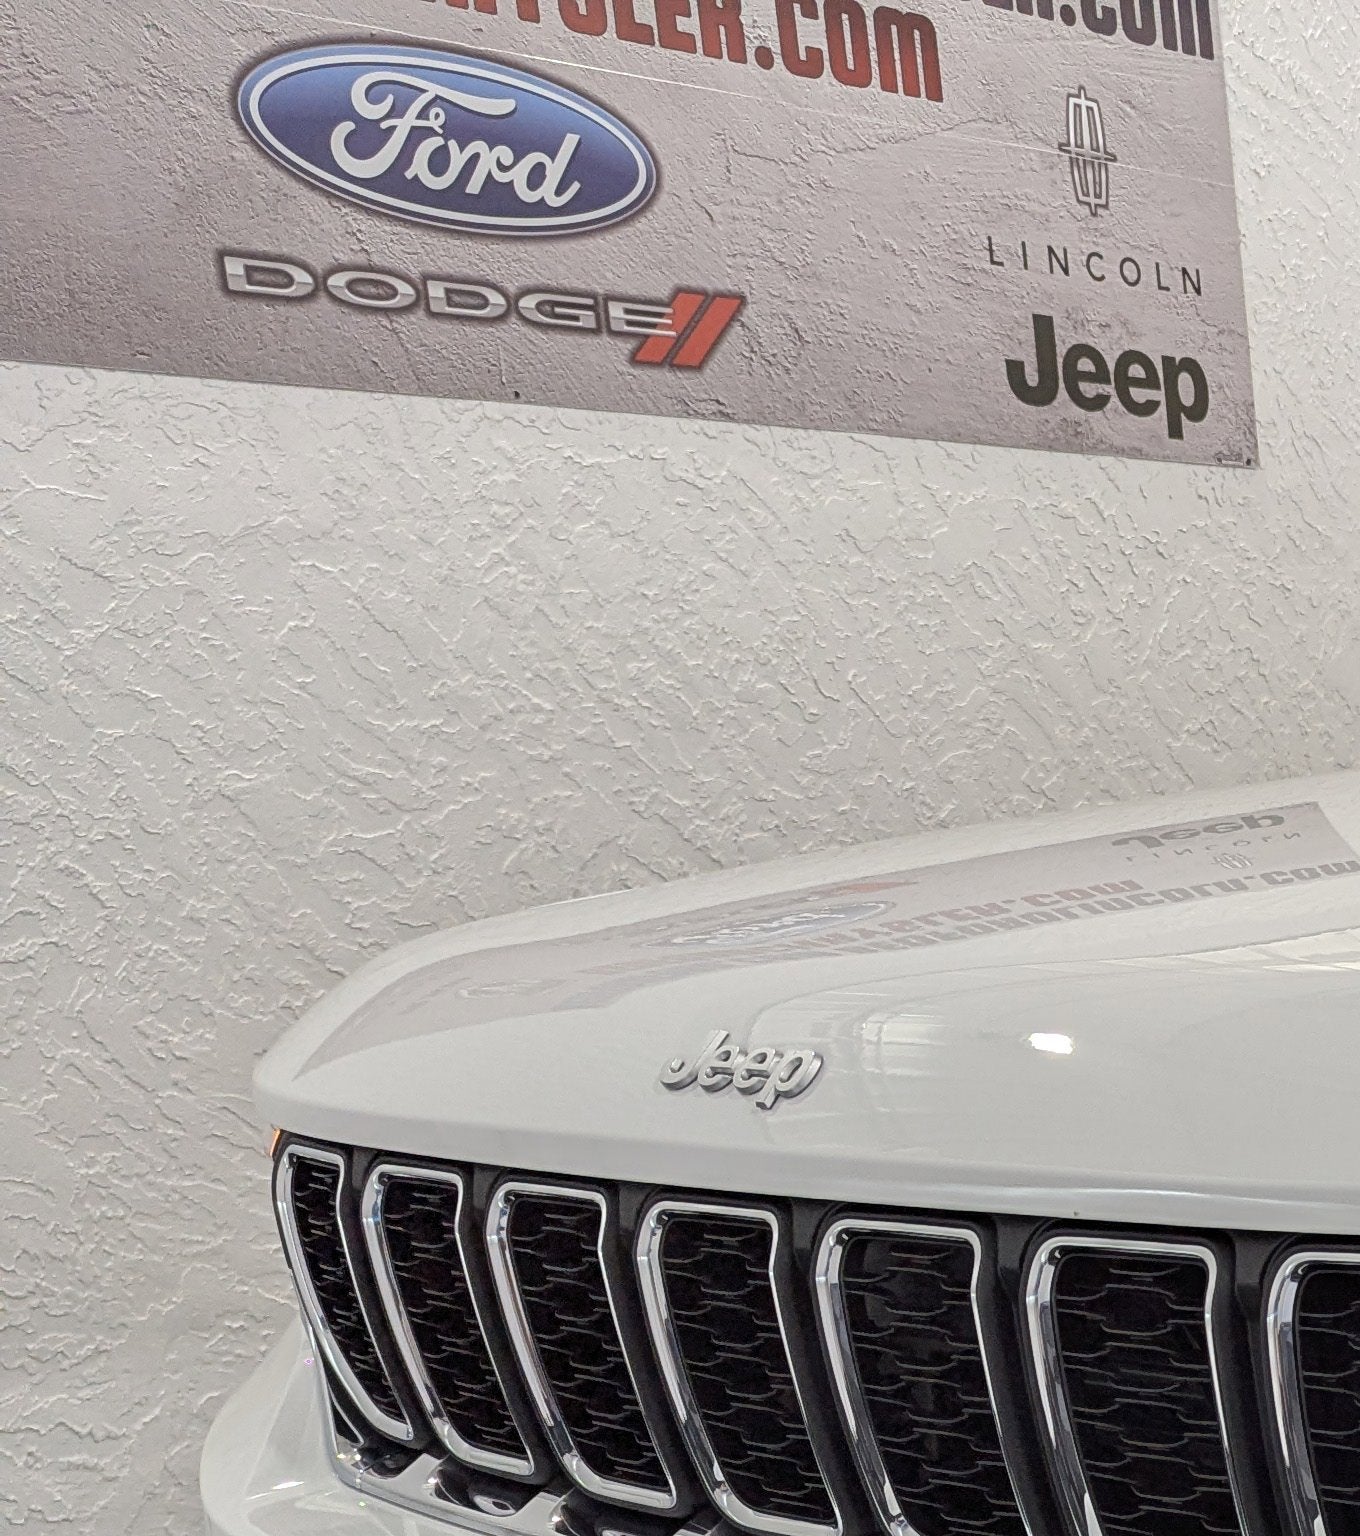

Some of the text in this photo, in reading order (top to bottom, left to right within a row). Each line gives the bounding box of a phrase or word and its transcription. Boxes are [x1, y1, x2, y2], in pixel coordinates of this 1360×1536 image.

[331, 70, 581, 208] Ford
[224, 255, 677, 337] DODGE
[987, 235, 1202, 296] LINCOLN
[1005, 313, 1209, 440] Jeep
[660, 1029, 823, 1109] Jeep
